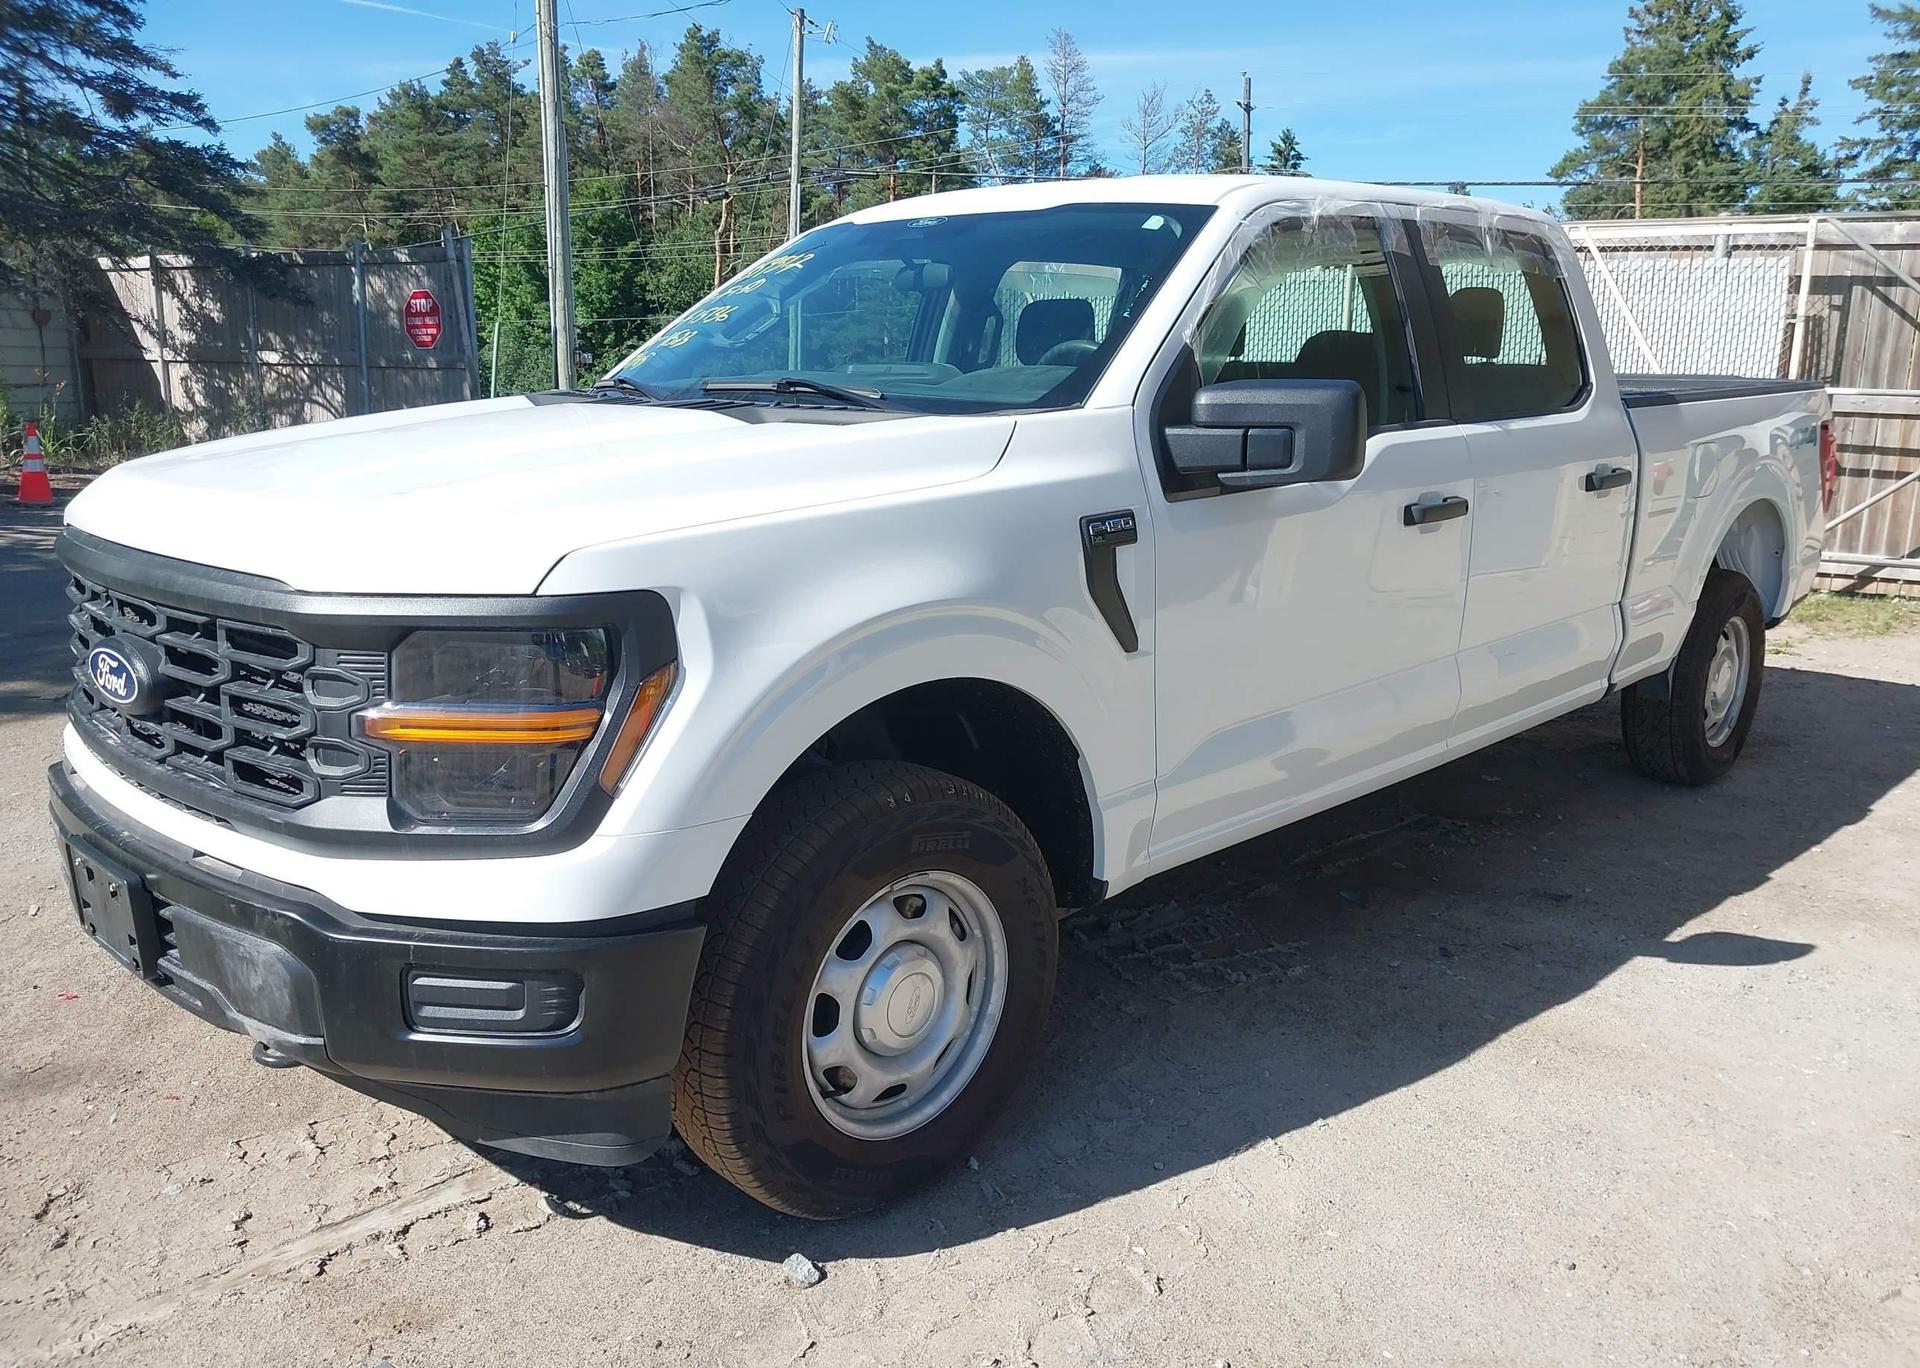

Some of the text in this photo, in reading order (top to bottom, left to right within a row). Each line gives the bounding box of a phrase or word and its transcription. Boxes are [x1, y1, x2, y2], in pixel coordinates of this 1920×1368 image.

[410, 298, 433, 313] STOP
[1089, 517, 1134, 535] F-150
[97, 653, 127, 697] Ford
[911, 831, 971, 853] PIRELLI
